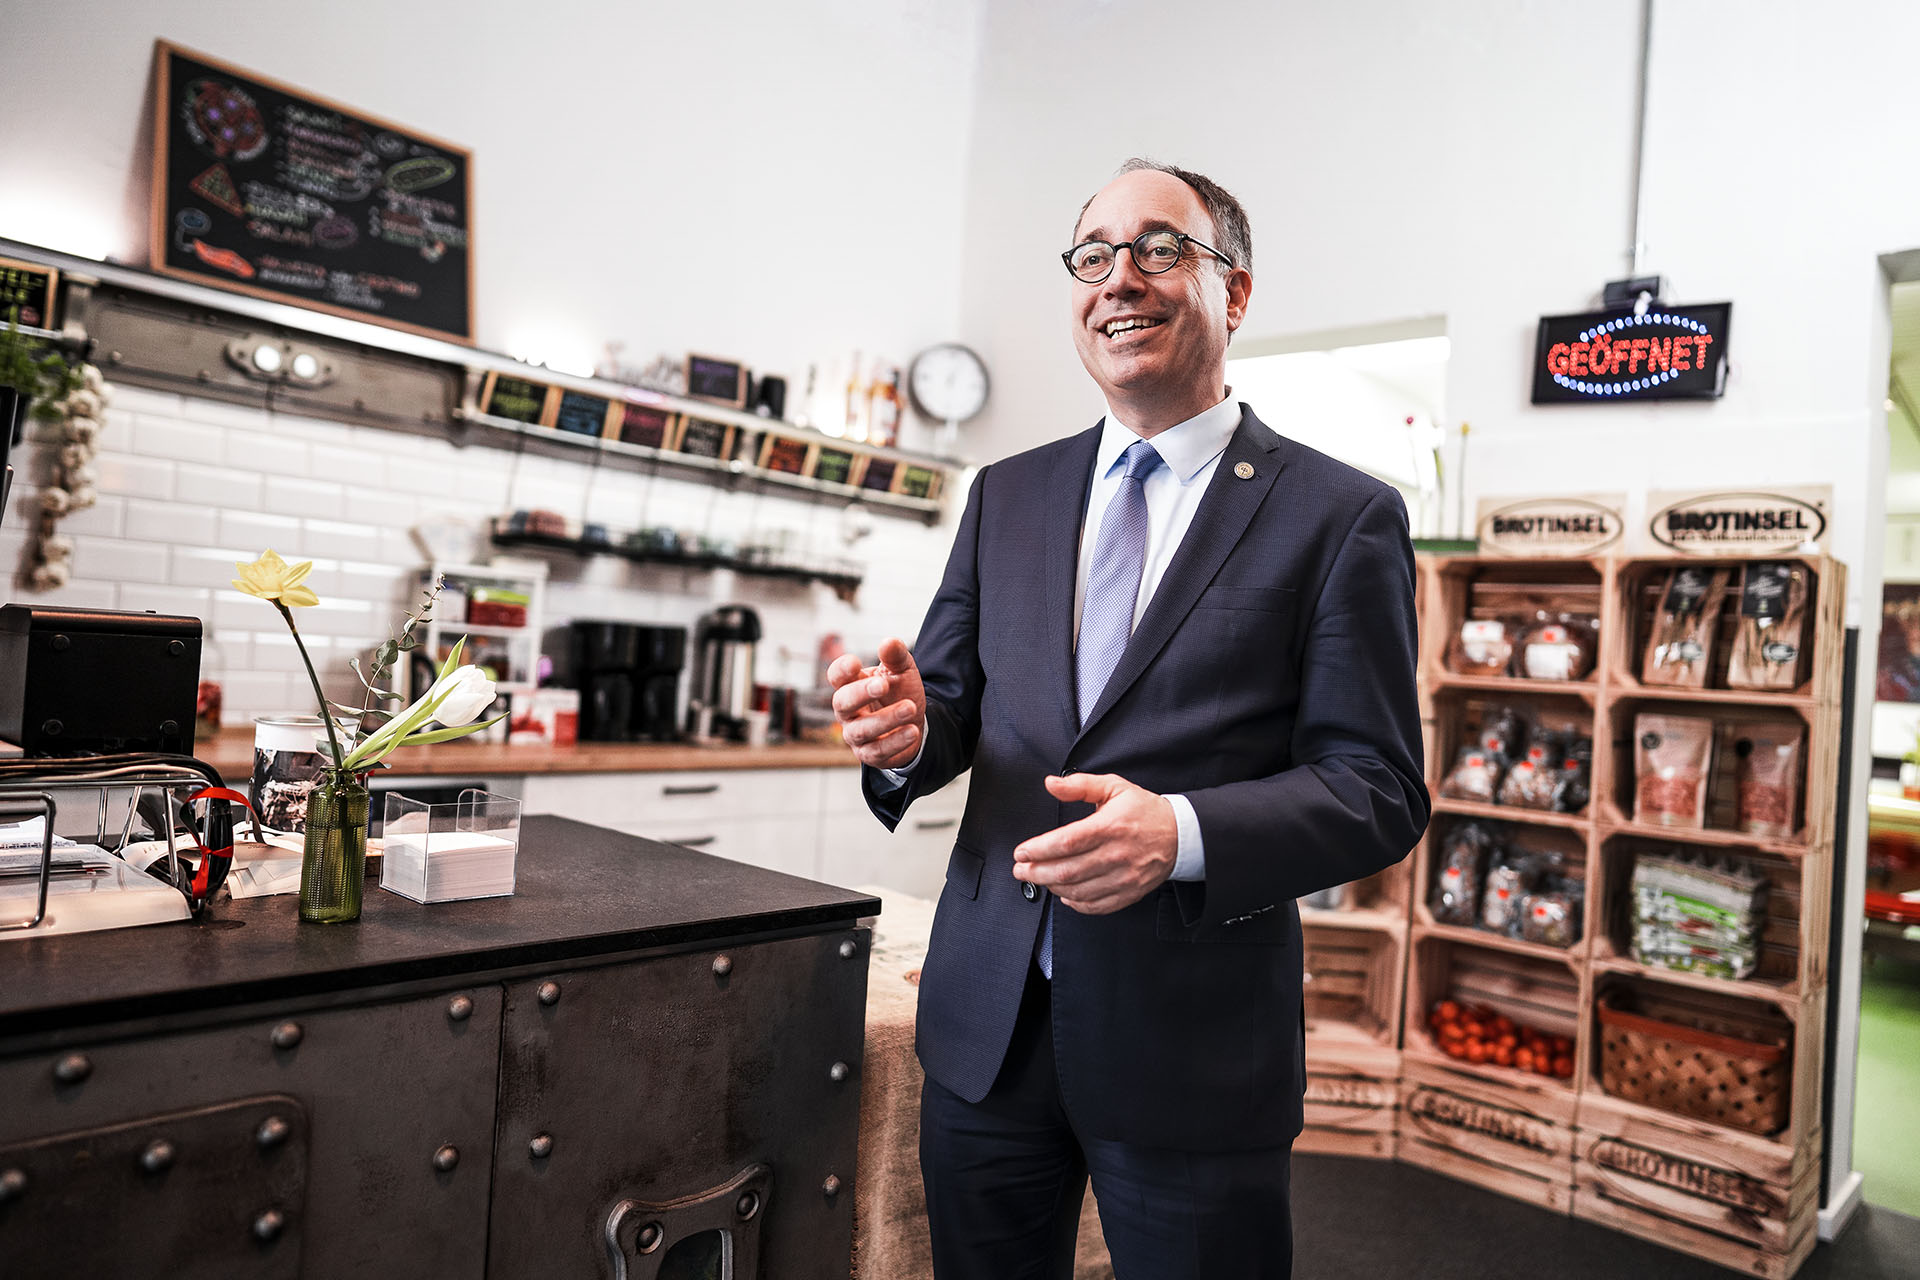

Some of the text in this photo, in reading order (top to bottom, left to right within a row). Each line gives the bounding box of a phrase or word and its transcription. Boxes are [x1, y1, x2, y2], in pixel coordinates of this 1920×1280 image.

[1548, 333, 1713, 376] GEÖFFNET
[1493, 515, 1608, 535] BROTINSEL
[1667, 510, 1808, 531] BROTINSEL
